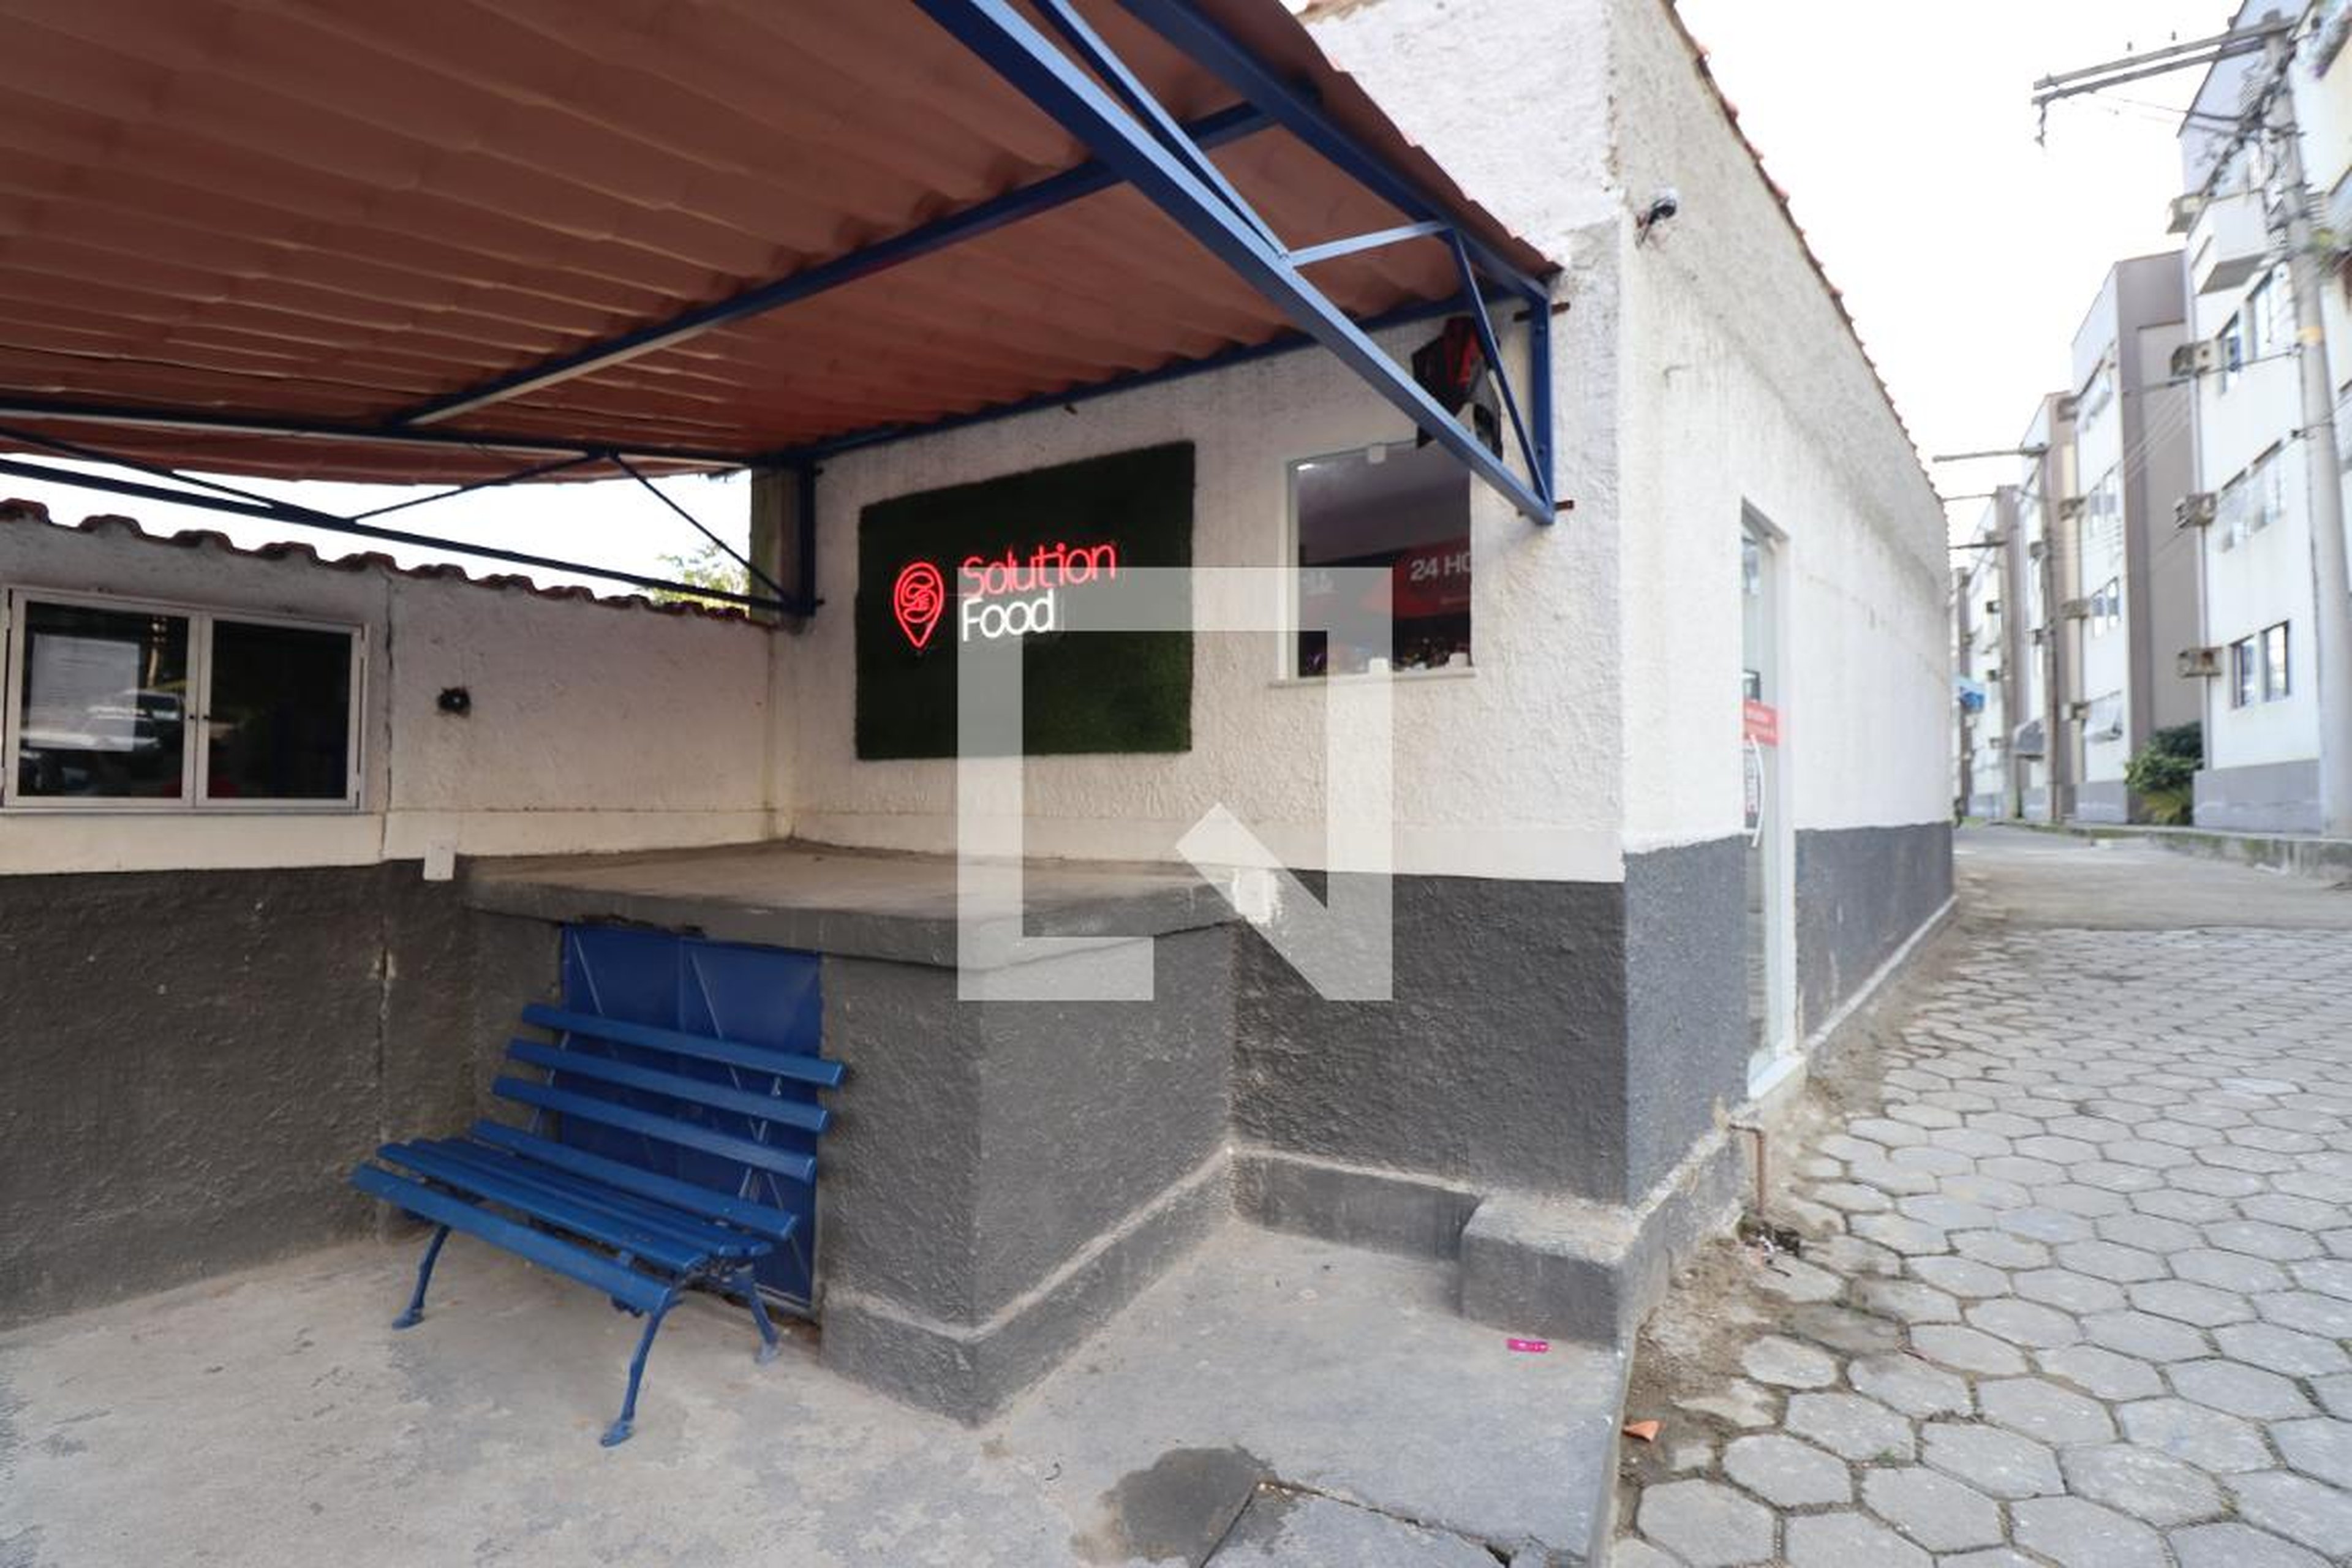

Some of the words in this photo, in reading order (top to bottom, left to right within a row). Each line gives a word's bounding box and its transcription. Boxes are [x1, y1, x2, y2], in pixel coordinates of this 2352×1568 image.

[962, 541, 1115, 598] Solution
[1410, 557, 1438, 581] 24
[962, 587, 1054, 641] Food
